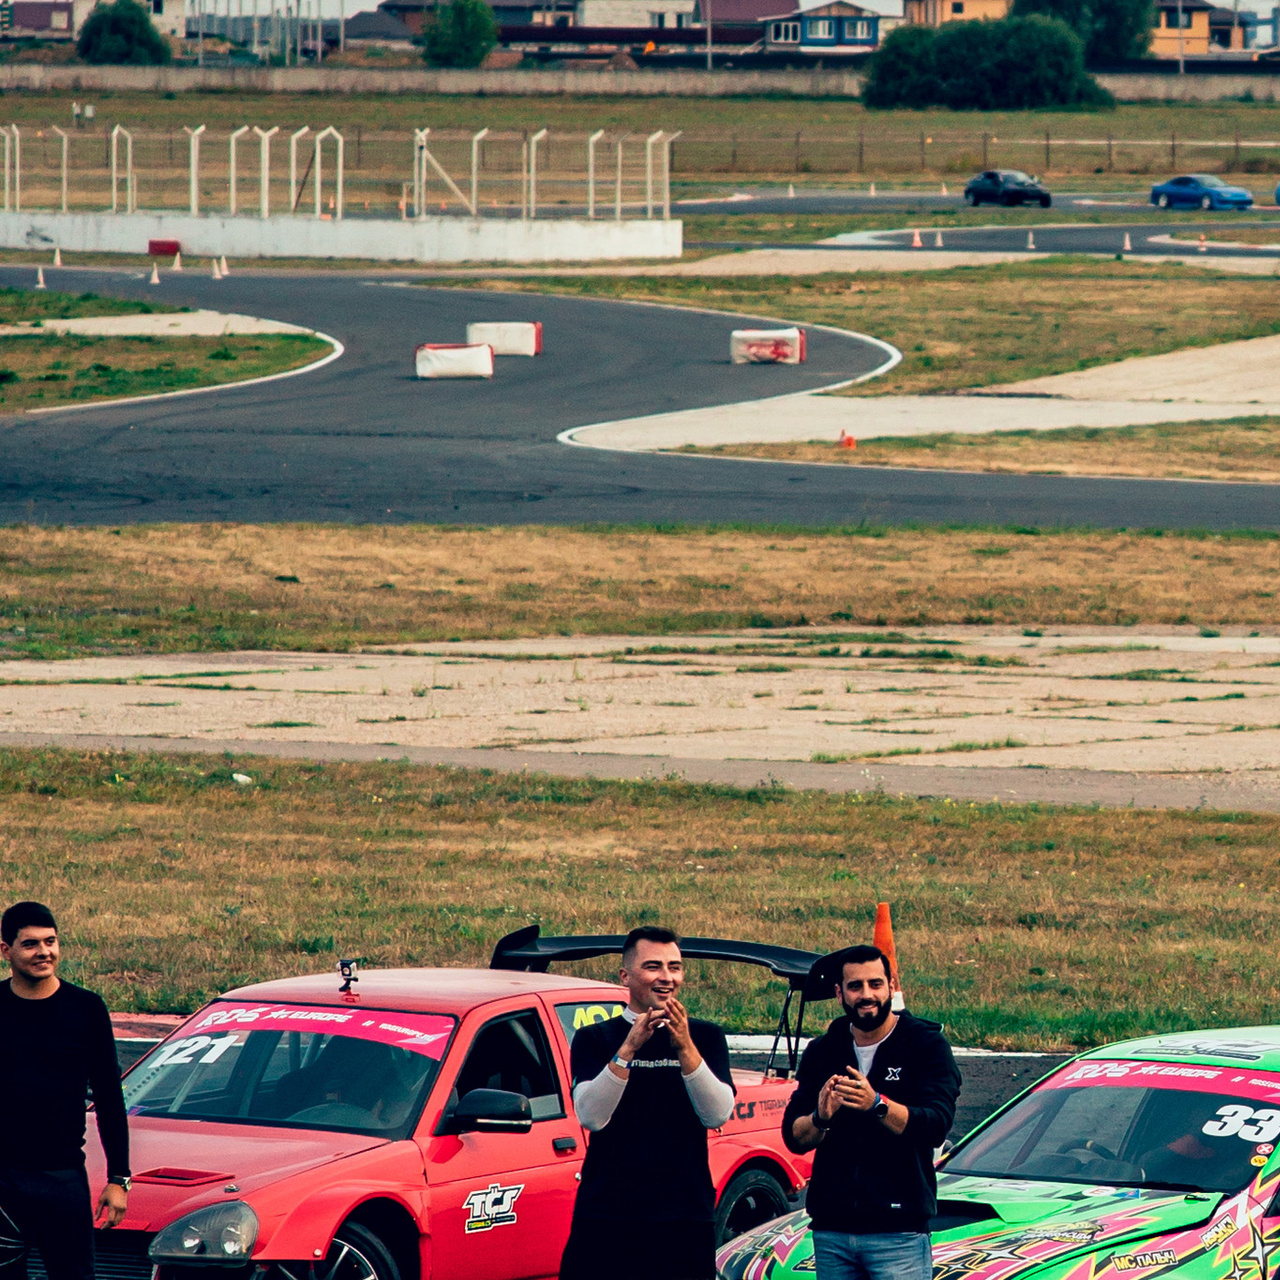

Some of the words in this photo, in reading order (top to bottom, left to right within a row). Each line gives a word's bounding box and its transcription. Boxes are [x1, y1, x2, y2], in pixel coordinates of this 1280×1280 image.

[196, 1007, 270, 1028] RDS
[289, 1010, 353, 1023] EUROPE
[147, 1034, 240, 1069] 121
[1066, 1062, 1141, 1080] RDS
[1156, 1066, 1223, 1080] EUROPE
[729, 1101, 757, 1121] CS
[759, 1099, 787, 1111] TIGRAN
[468, 1187, 519, 1219] TCS
